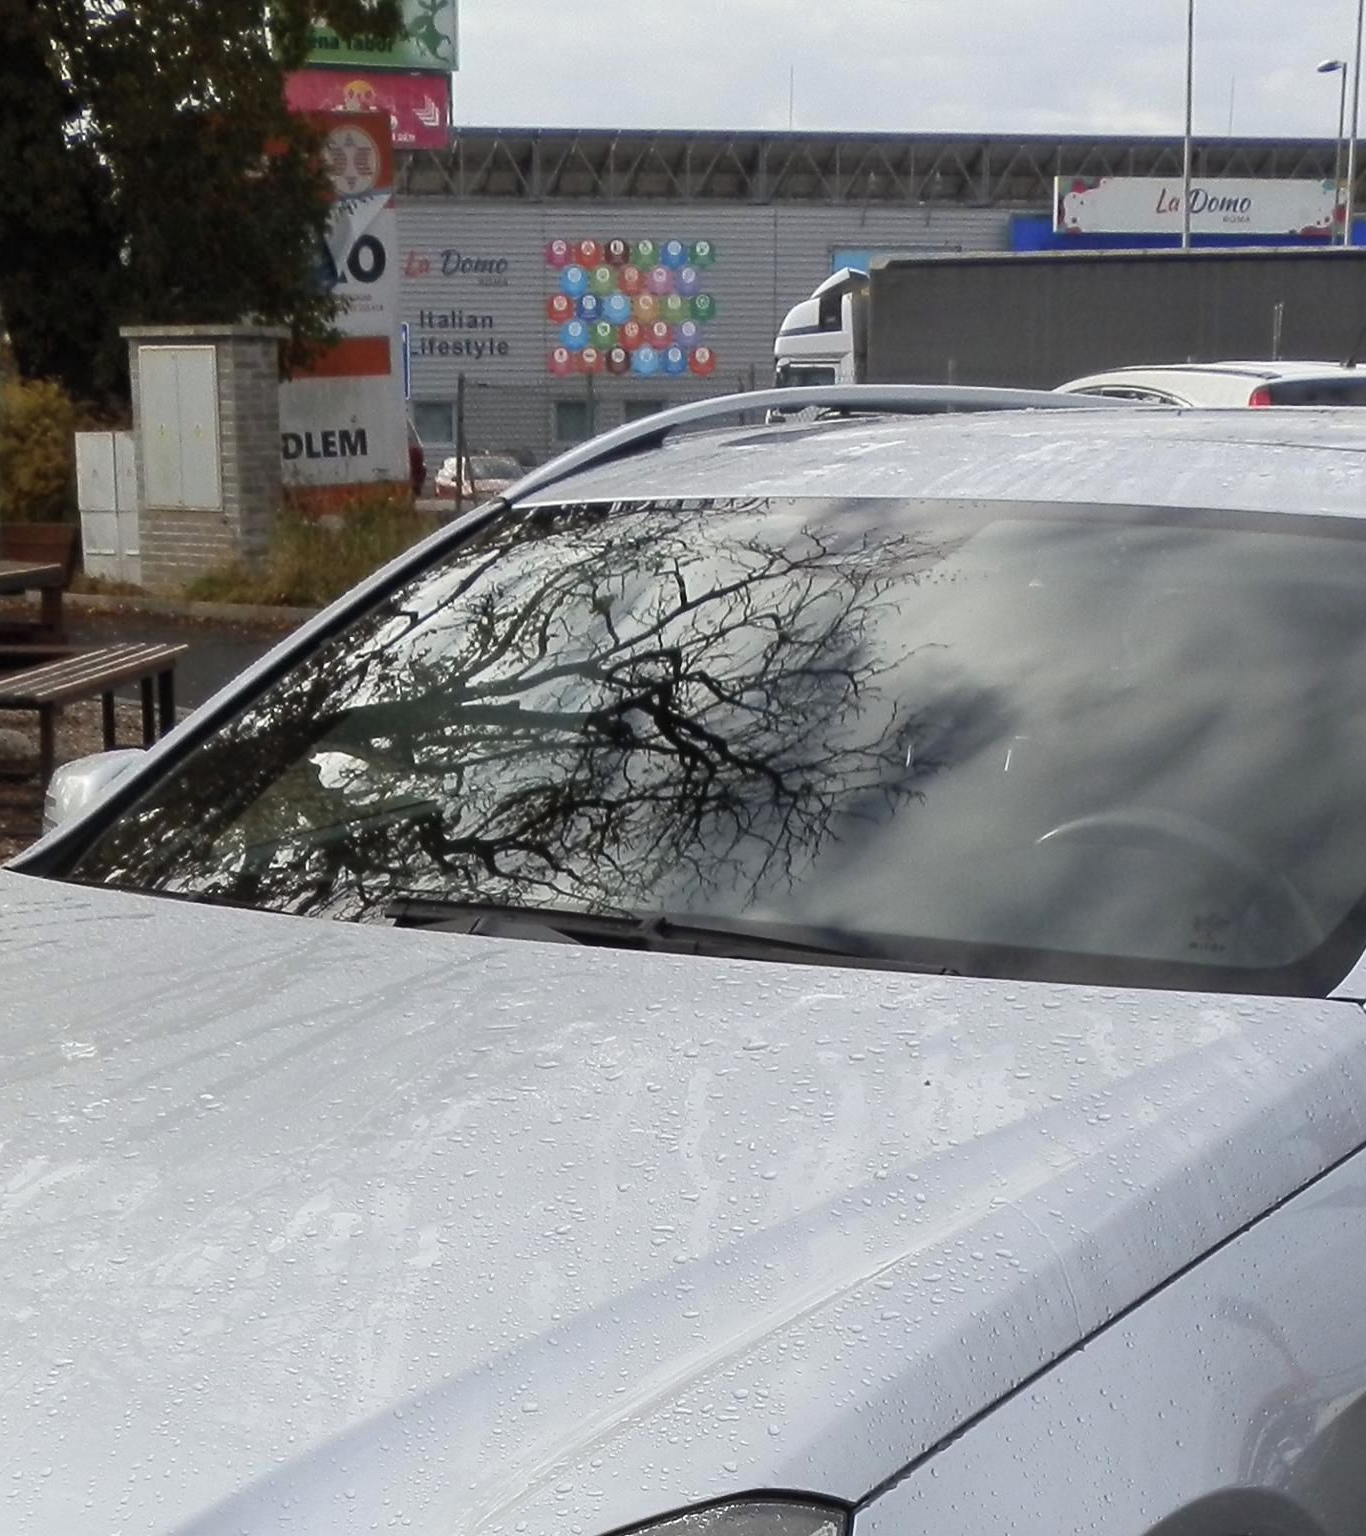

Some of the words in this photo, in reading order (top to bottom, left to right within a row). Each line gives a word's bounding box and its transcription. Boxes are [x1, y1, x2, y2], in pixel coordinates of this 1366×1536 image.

[1156, 187, 1181, 214] La
[1189, 188, 1252, 214] Domo
[403, 250, 431, 278] La
[441, 248, 508, 276] Domo
[420, 310, 493, 329] Italian
[411, 338, 509, 360] ifestyle
